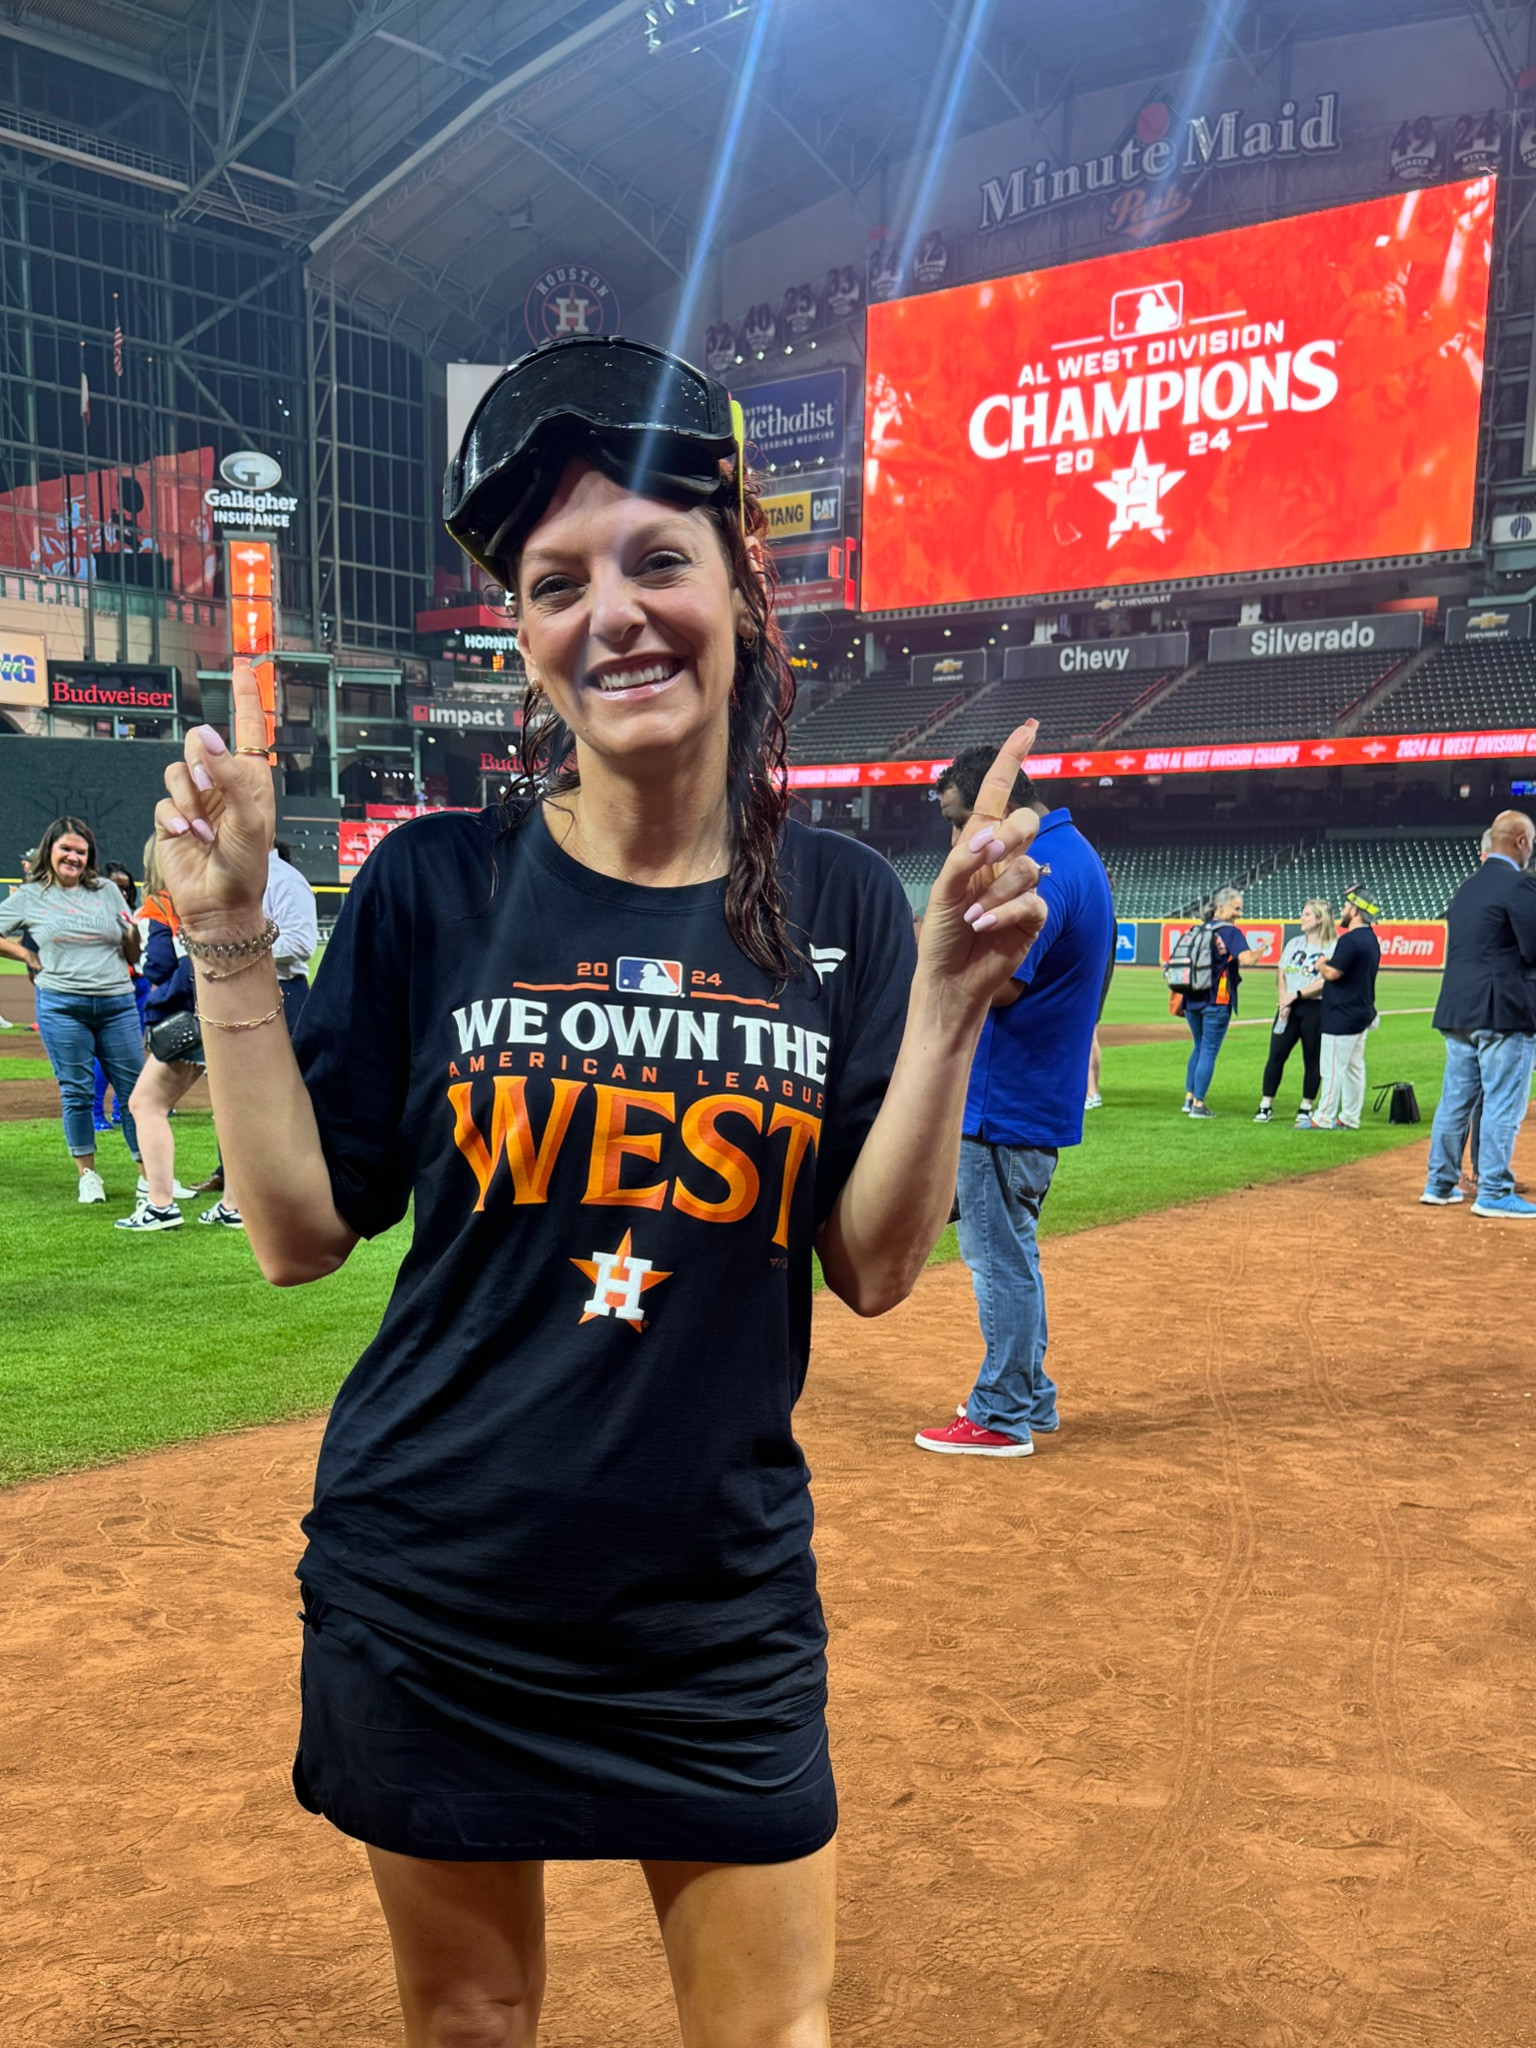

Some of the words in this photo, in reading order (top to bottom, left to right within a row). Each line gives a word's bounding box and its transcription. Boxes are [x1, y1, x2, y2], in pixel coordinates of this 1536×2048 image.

[979, 138, 1171, 229] Minute
[1183, 95, 1336, 168] Maid
[1107, 185, 1186, 233] Park
[536, 268, 609, 295] HOUSTON
[556, 298, 589, 332] H
[1018, 362, 1050, 388] AL
[1057, 346, 1139, 381] WEST
[1147, 320, 1285, 365] DIVISION
[968, 340, 1339, 460] CHAMPIONS
[760, 438, 794, 451] LEADING
[796, 430, 835, 445] MEDICINE
[1055, 448, 1094, 475] 20
[1187, 428, 1231, 456] 24
[204, 488, 298, 512] Gallagher
[765, 504, 804, 526] TANG
[813, 498, 838, 522] CAT
[213, 510, 290, 528] INSURANCE
[1119, 594, 1172, 607] CHEVROLET
[1250, 620, 1375, 656] Silverado
[1059, 645, 1130, 671] Chevy
[52, 682, 173, 706] Budweiser
[429, 704, 505, 727] impact
[1143, 752, 1170, 770] 2024
[1182, 750, 1211, 768] WEST
[1254, 745, 1300, 764] CHAMPS
[1396, 738, 1428, 758] 2024
[1426, 737, 1441, 757] AL
[1442, 736, 1476, 756] WEST
[1474, 733, 1528, 754] DIVISION
[576, 962, 609, 978] 20
[691, 970, 722, 986] 24
[452, 998, 548, 1054] WE
[560, 1001, 720, 1061] OWN
[733, 1015, 830, 1085] THE
[449, 1051, 658, 1084] AMERICAN
[697, 1070, 823, 1109] LEAGUE
[447, 1075, 823, 1250] WEST
[584, 1252, 653, 1320] H
